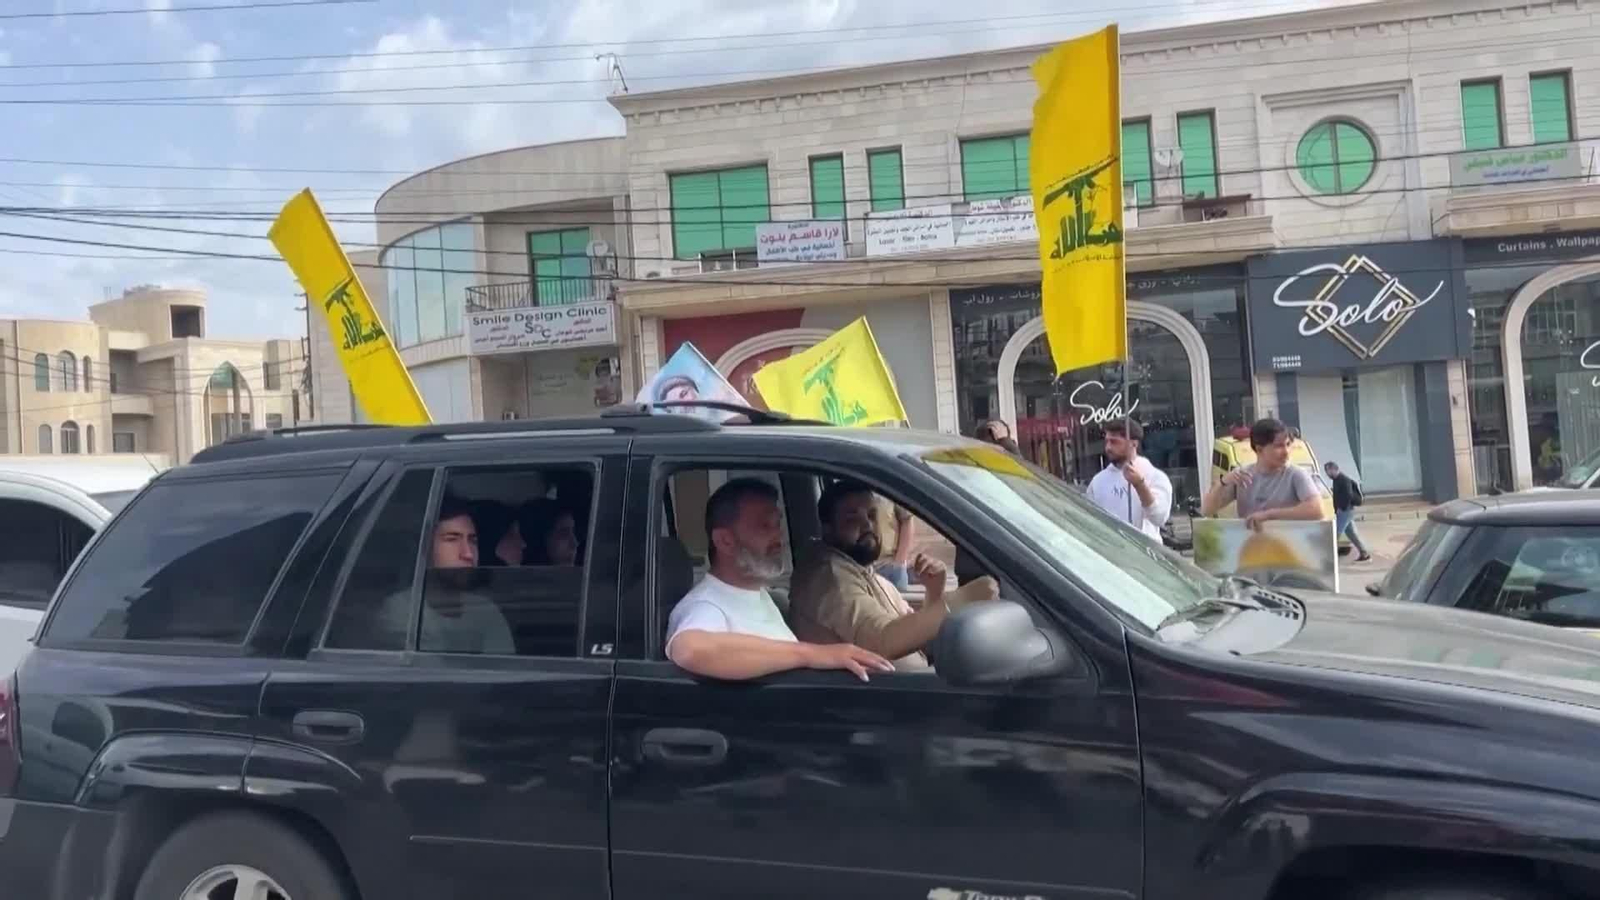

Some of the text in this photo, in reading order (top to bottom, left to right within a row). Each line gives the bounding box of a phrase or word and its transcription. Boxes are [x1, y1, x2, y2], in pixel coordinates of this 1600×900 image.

[789, 229, 821, 244] قاسم
[825, 227, 839, 240] لارا
[1498, 240, 1547, 252] Curtains
[1009, 289, 1041, 300] روشات
[1273, 263, 1443, 336] Solo
[473, 306, 607, 326] Smile Design Clinic
[1070, 380, 1139, 425] Solo
[591, 643, 614, 655] LS
